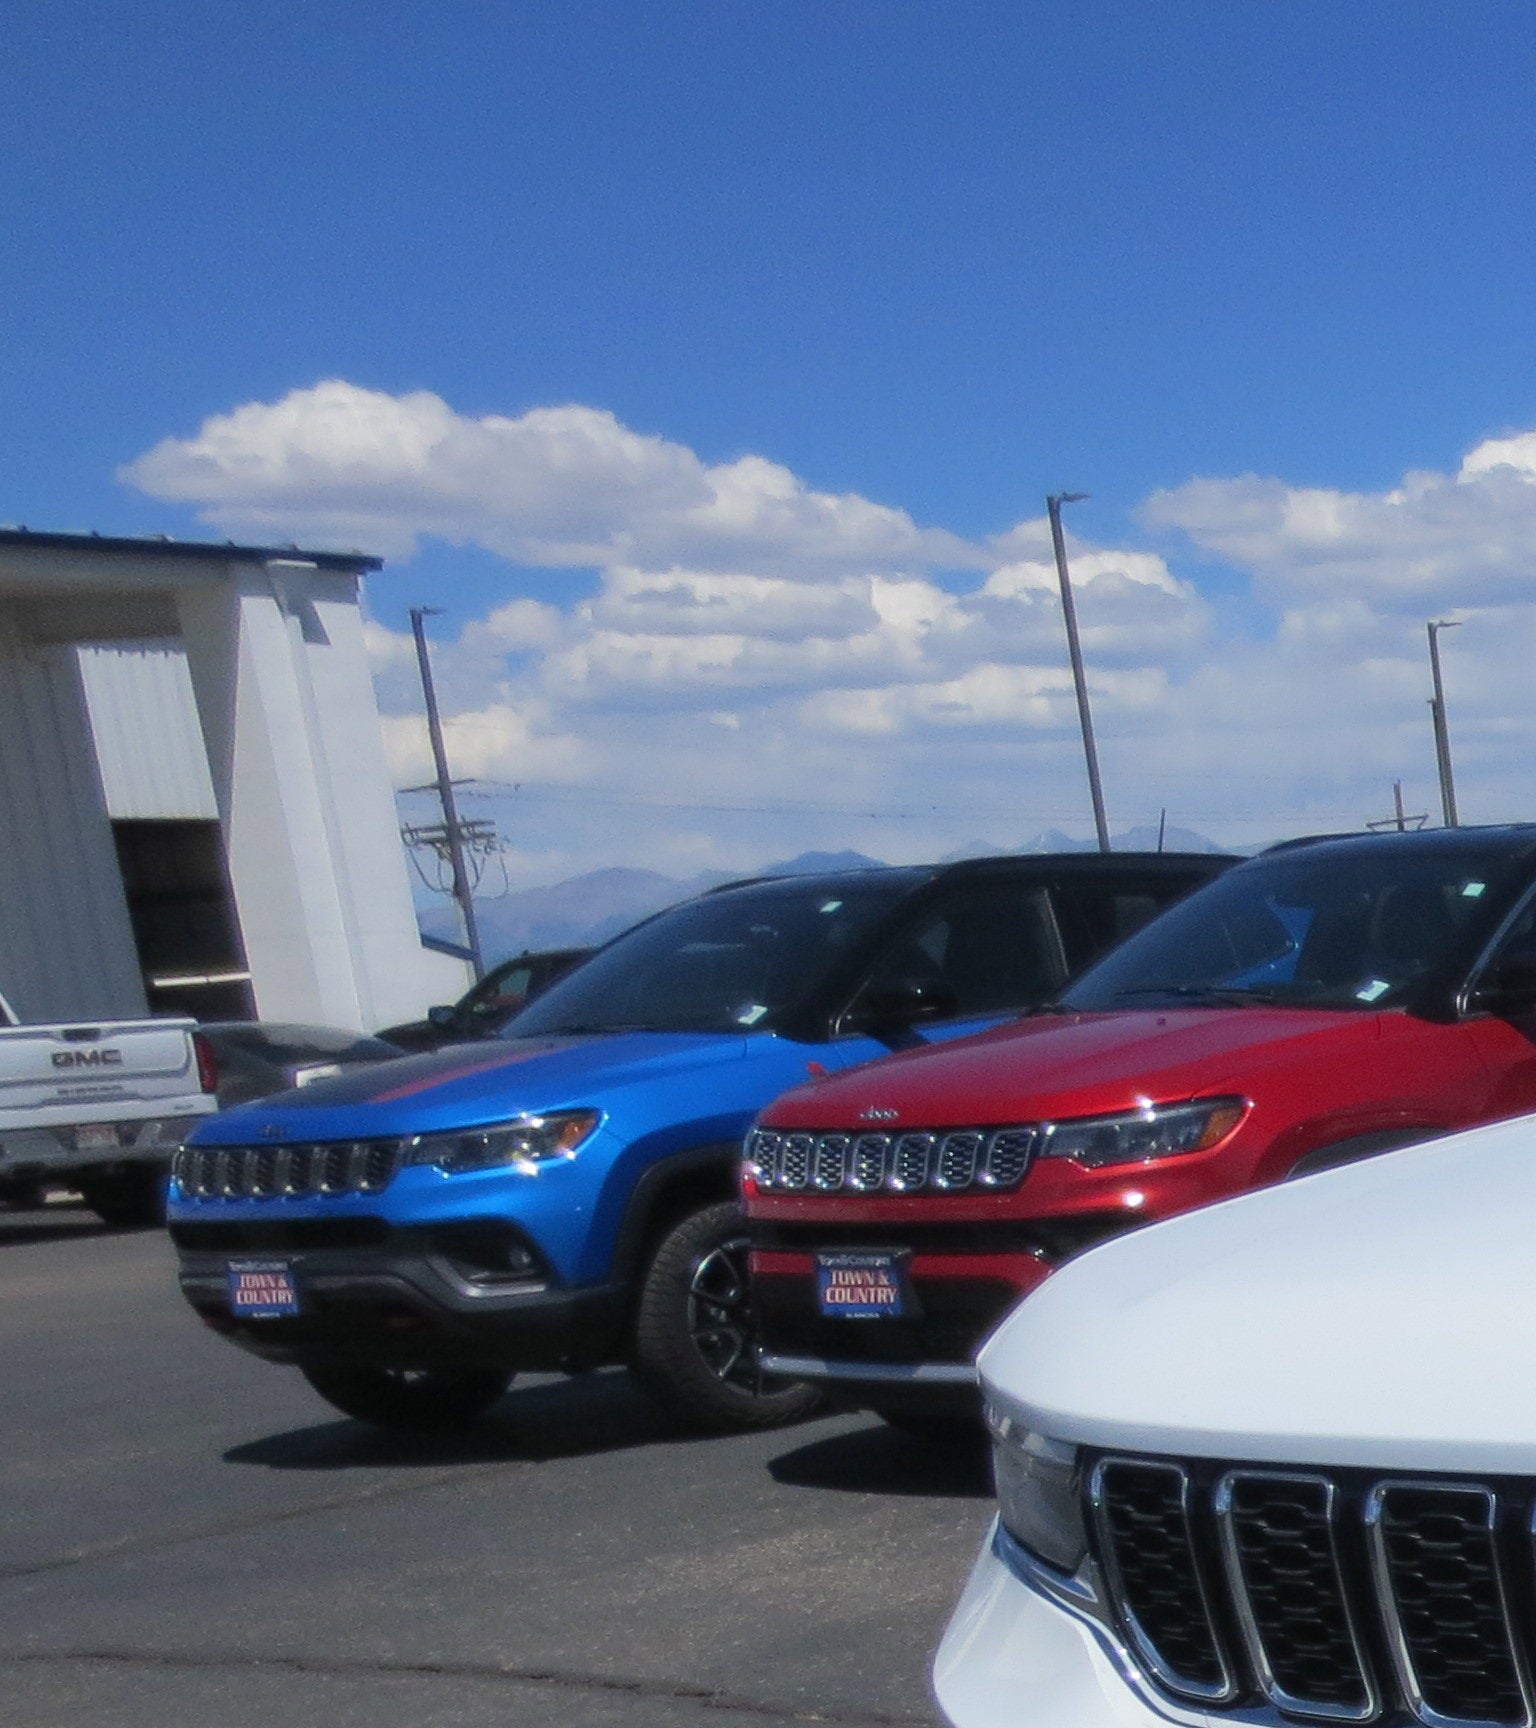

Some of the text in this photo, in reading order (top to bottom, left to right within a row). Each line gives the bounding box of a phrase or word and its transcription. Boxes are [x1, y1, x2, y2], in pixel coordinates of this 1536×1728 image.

[52, 1049, 123, 1069] GMC
[239, 1273, 287, 1289] TOWN &
[830, 1270, 890, 1286] TOWN &
[236, 1288, 294, 1306] COUNTRY
[825, 1286, 897, 1305] COUNTRY
